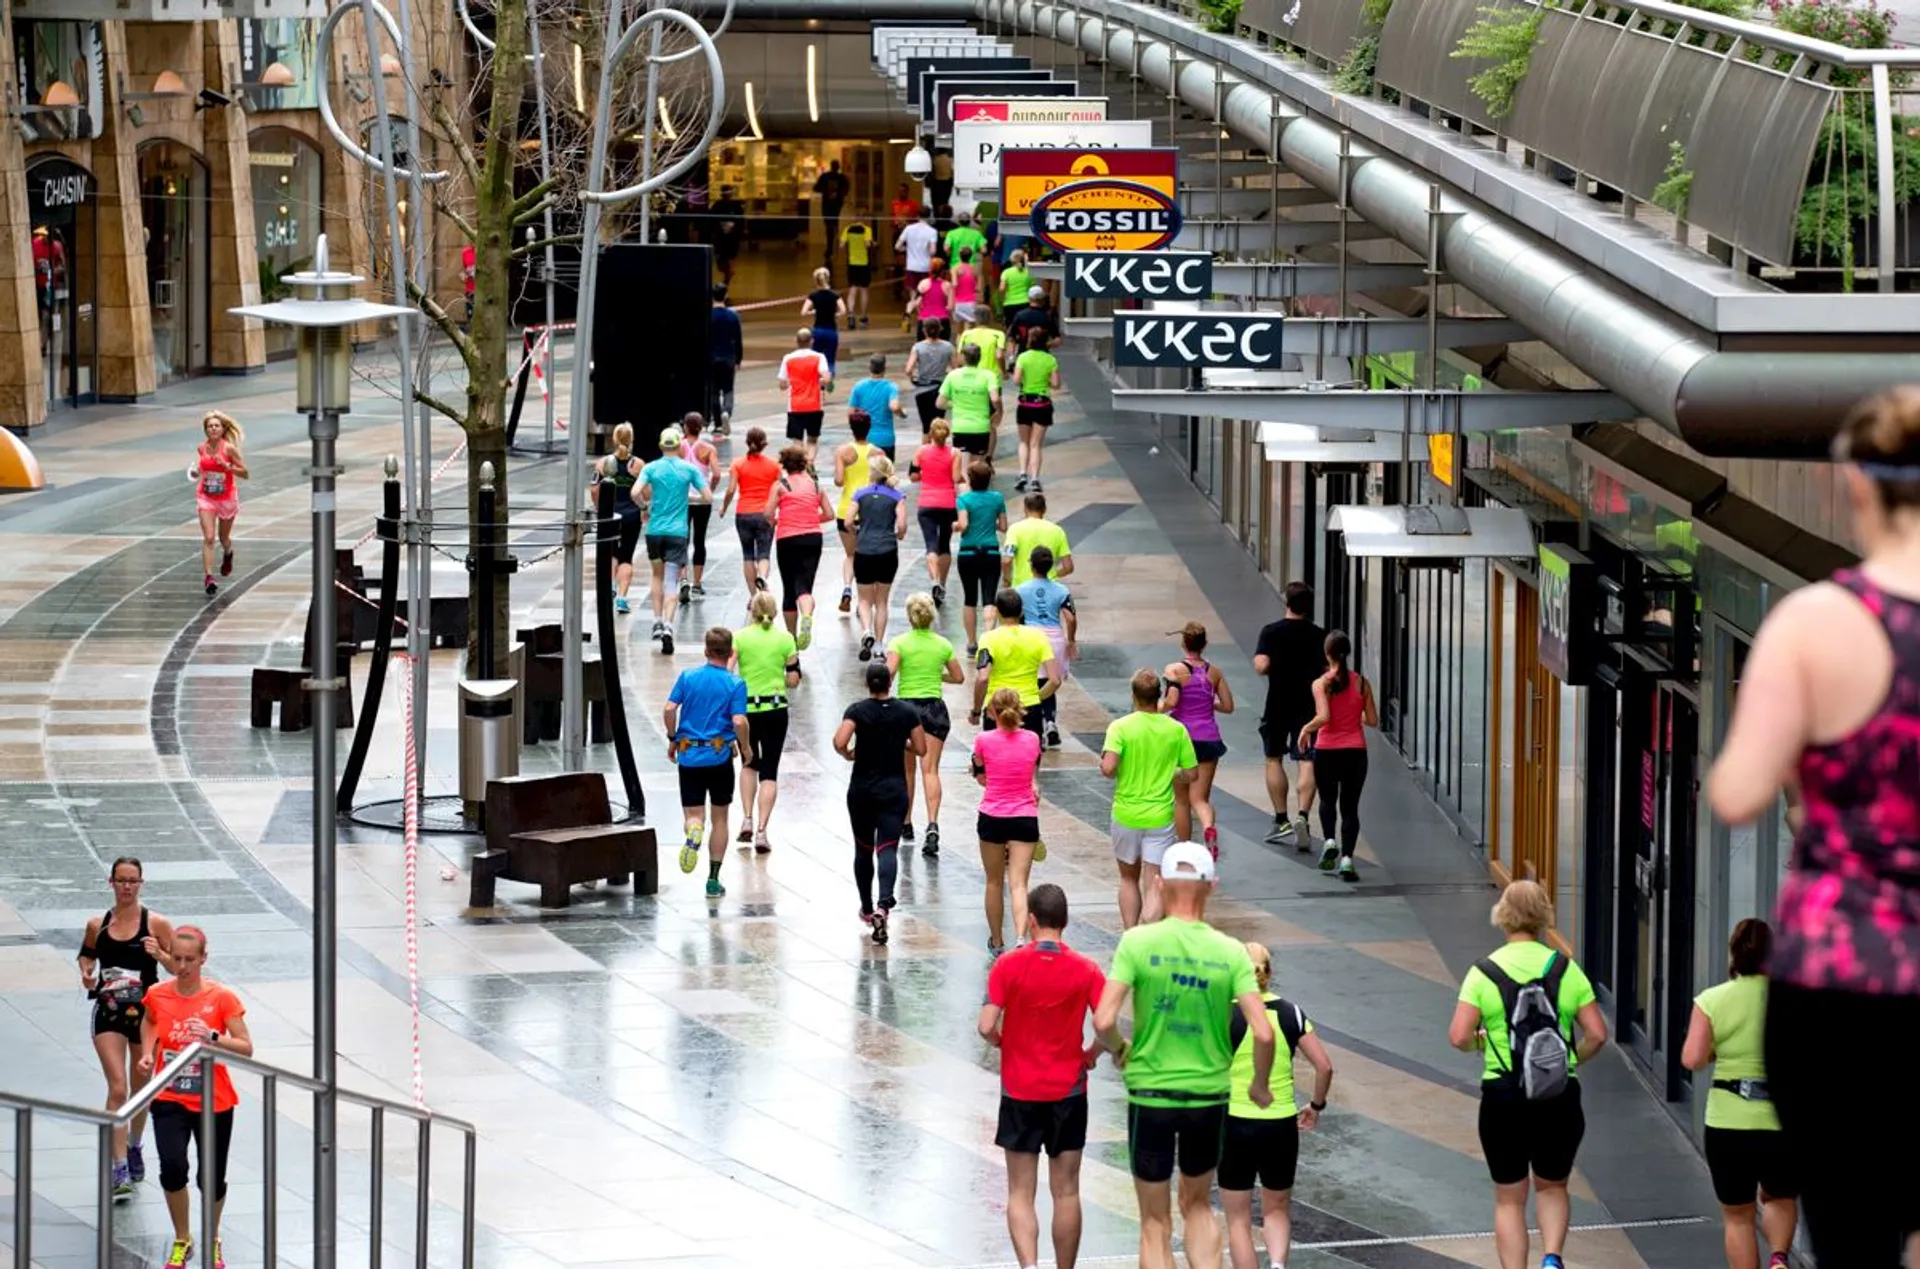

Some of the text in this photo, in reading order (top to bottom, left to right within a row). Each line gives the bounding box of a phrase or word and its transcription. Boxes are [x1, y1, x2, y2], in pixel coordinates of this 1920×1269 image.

[45, 174, 87, 207] CHASIN'
[1060, 190, 1154, 206] AUTHENTIC
[1046, 210, 1168, 231] FOSSIL
[265, 219, 299, 248] SALE
